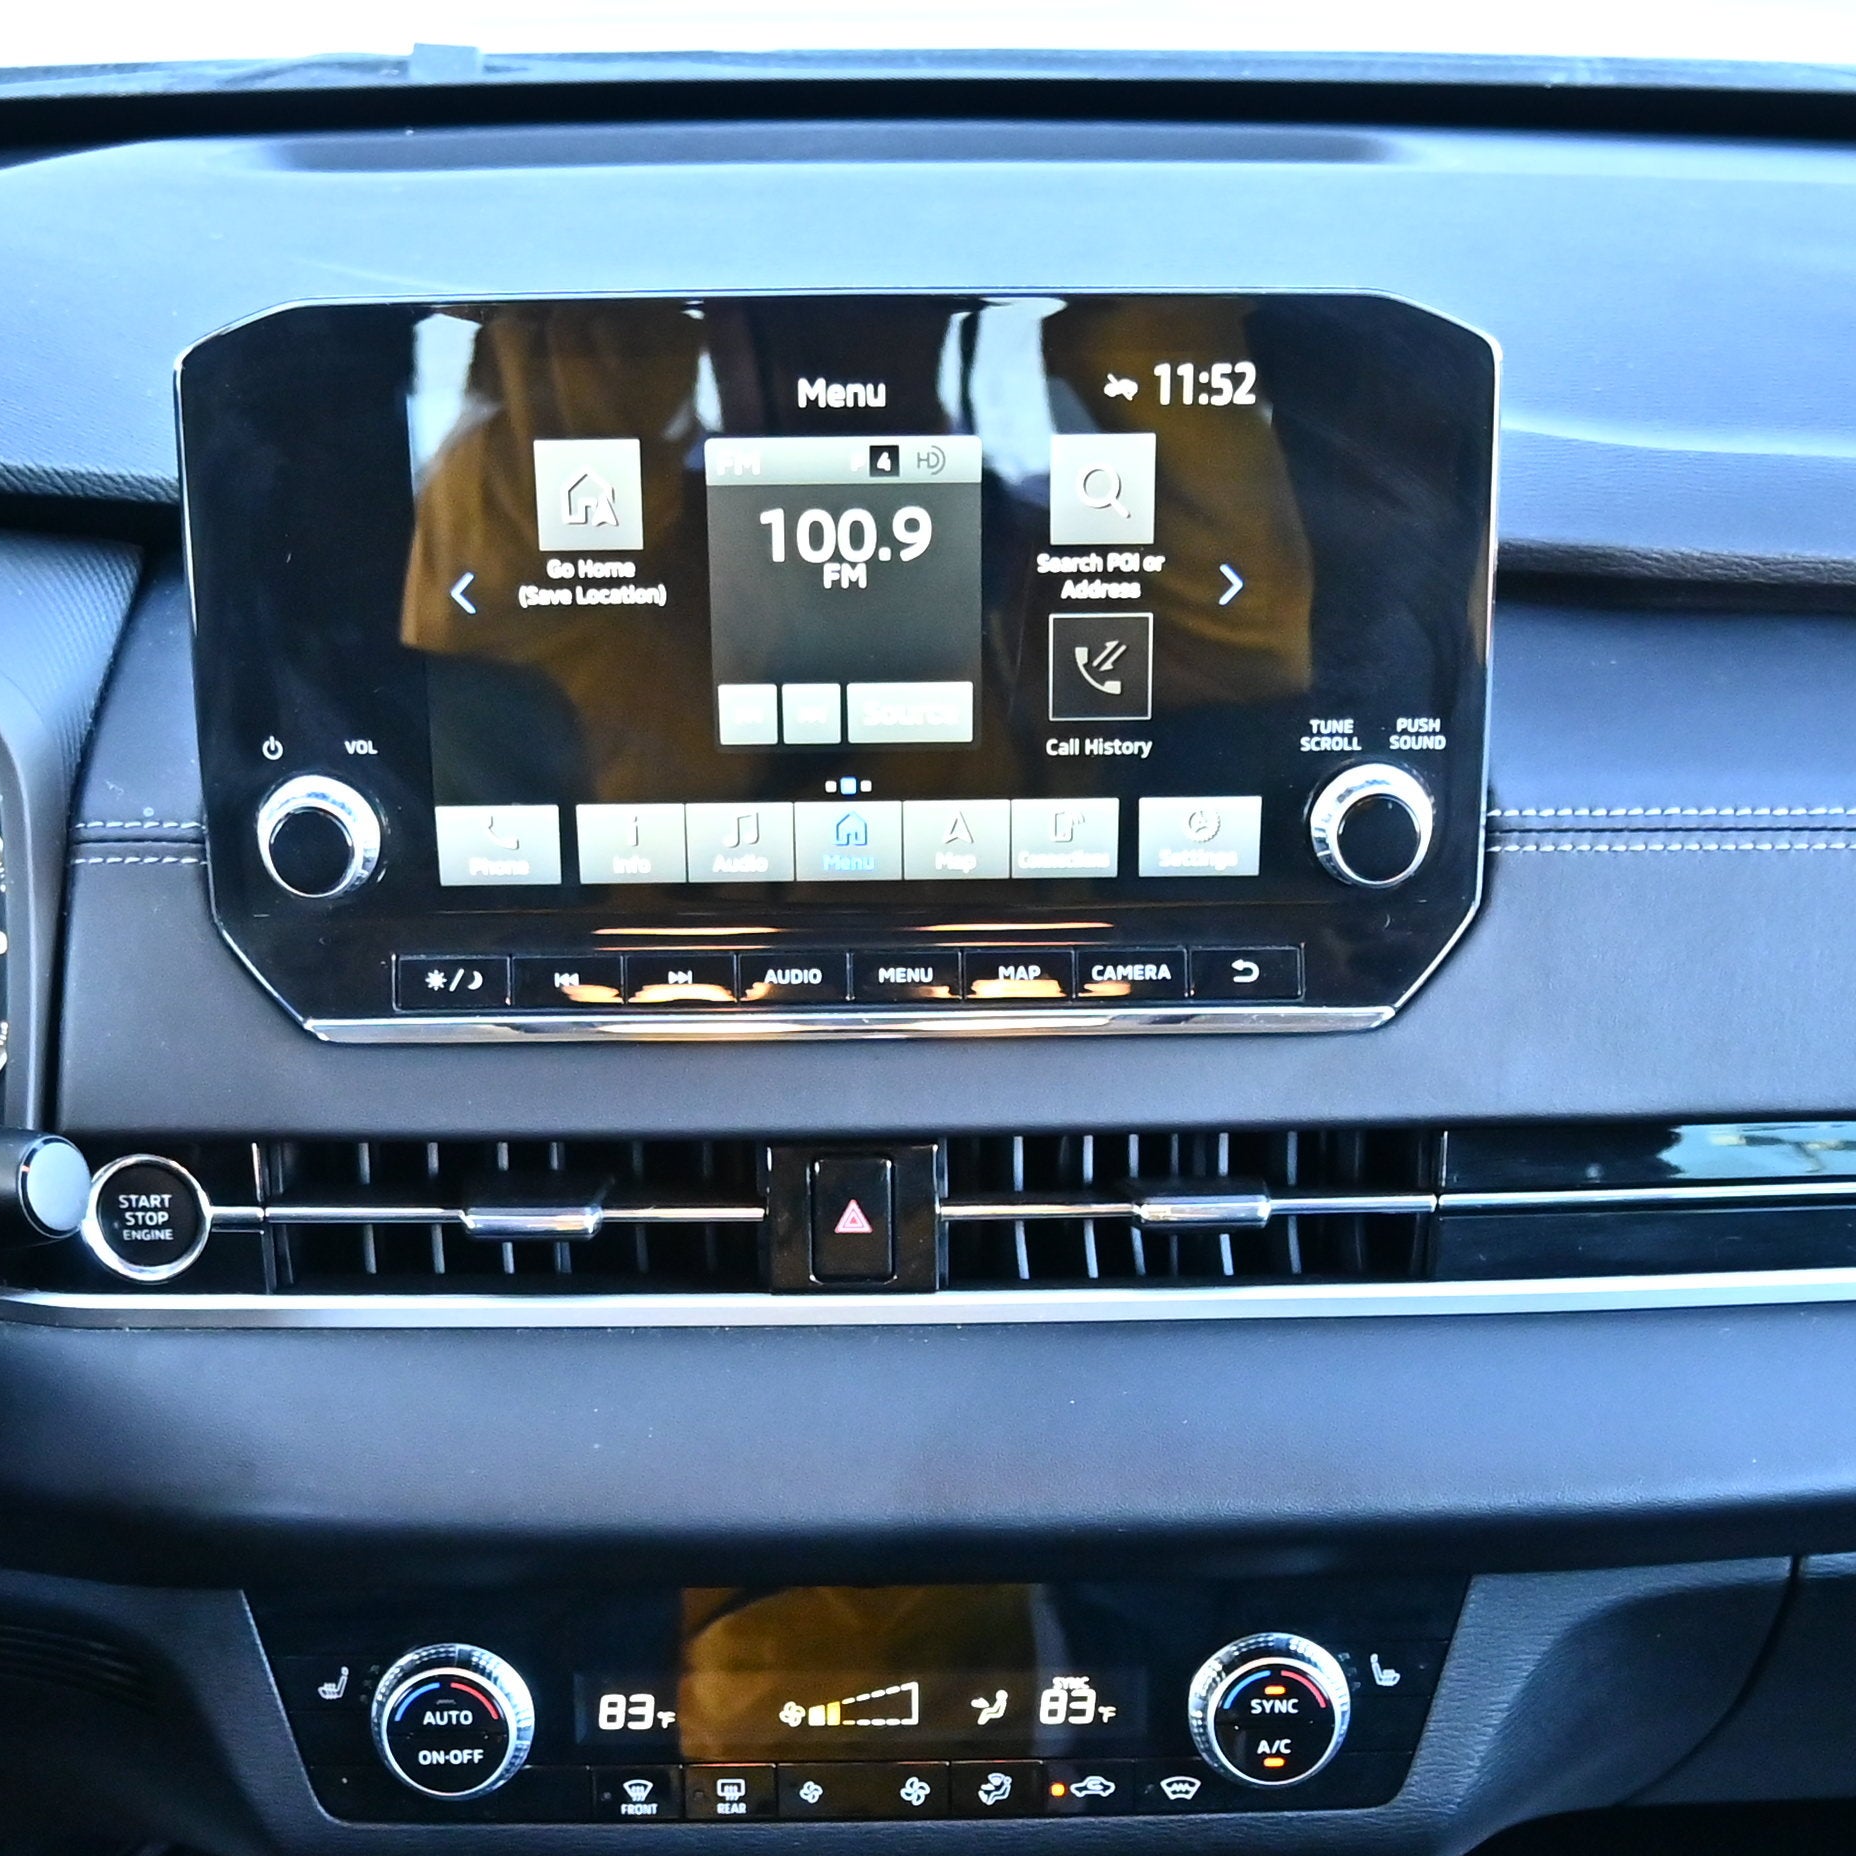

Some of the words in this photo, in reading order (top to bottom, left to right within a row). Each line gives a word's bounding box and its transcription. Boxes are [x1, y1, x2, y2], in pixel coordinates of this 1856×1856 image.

[797, 377, 886, 408] Menu
[1154, 361, 1257, 406] 11:52
[876, 451, 892, 472] 4
[759, 505, 933, 564] 100.9
[547, 559, 575, 580] Go
[578, 559, 636, 579] Home
[1036, 553, 1104, 575] Search
[1143, 556, 1165, 573] or
[822, 563, 868, 590] FM
[519, 584, 572, 609] (Save
[575, 584, 667, 608] Location)
[1061, 580, 1142, 601] Address
[1309, 718, 1355, 735] TUNE
[1396, 717, 1441, 734] PUSH
[344, 739, 379, 756] VOL
[1045, 737, 1080, 757] Call
[1084, 736, 1153, 758] History
[1300, 735, 1362, 752] SCROLL
[1389, 734, 1447, 751] SOUND
[612, 855, 653, 876] Info
[764, 967, 823, 986] AUDIO
[878, 965, 934, 985] MENU
[998, 964, 1041, 982] MAP
[1091, 964, 1172, 982] CAMERA
[118, 1193, 172, 1209] START
[124, 1211, 169, 1227] STOP
[122, 1229, 174, 1242] ENGINE
[1250, 1699, 1299, 1715] SYNC
[422, 1710, 473, 1727] AUTO
[1256, 1738, 1292, 1756] A/C
[620, 1803, 658, 1816] FRONT
[716, 1803, 746, 1815] REAR
